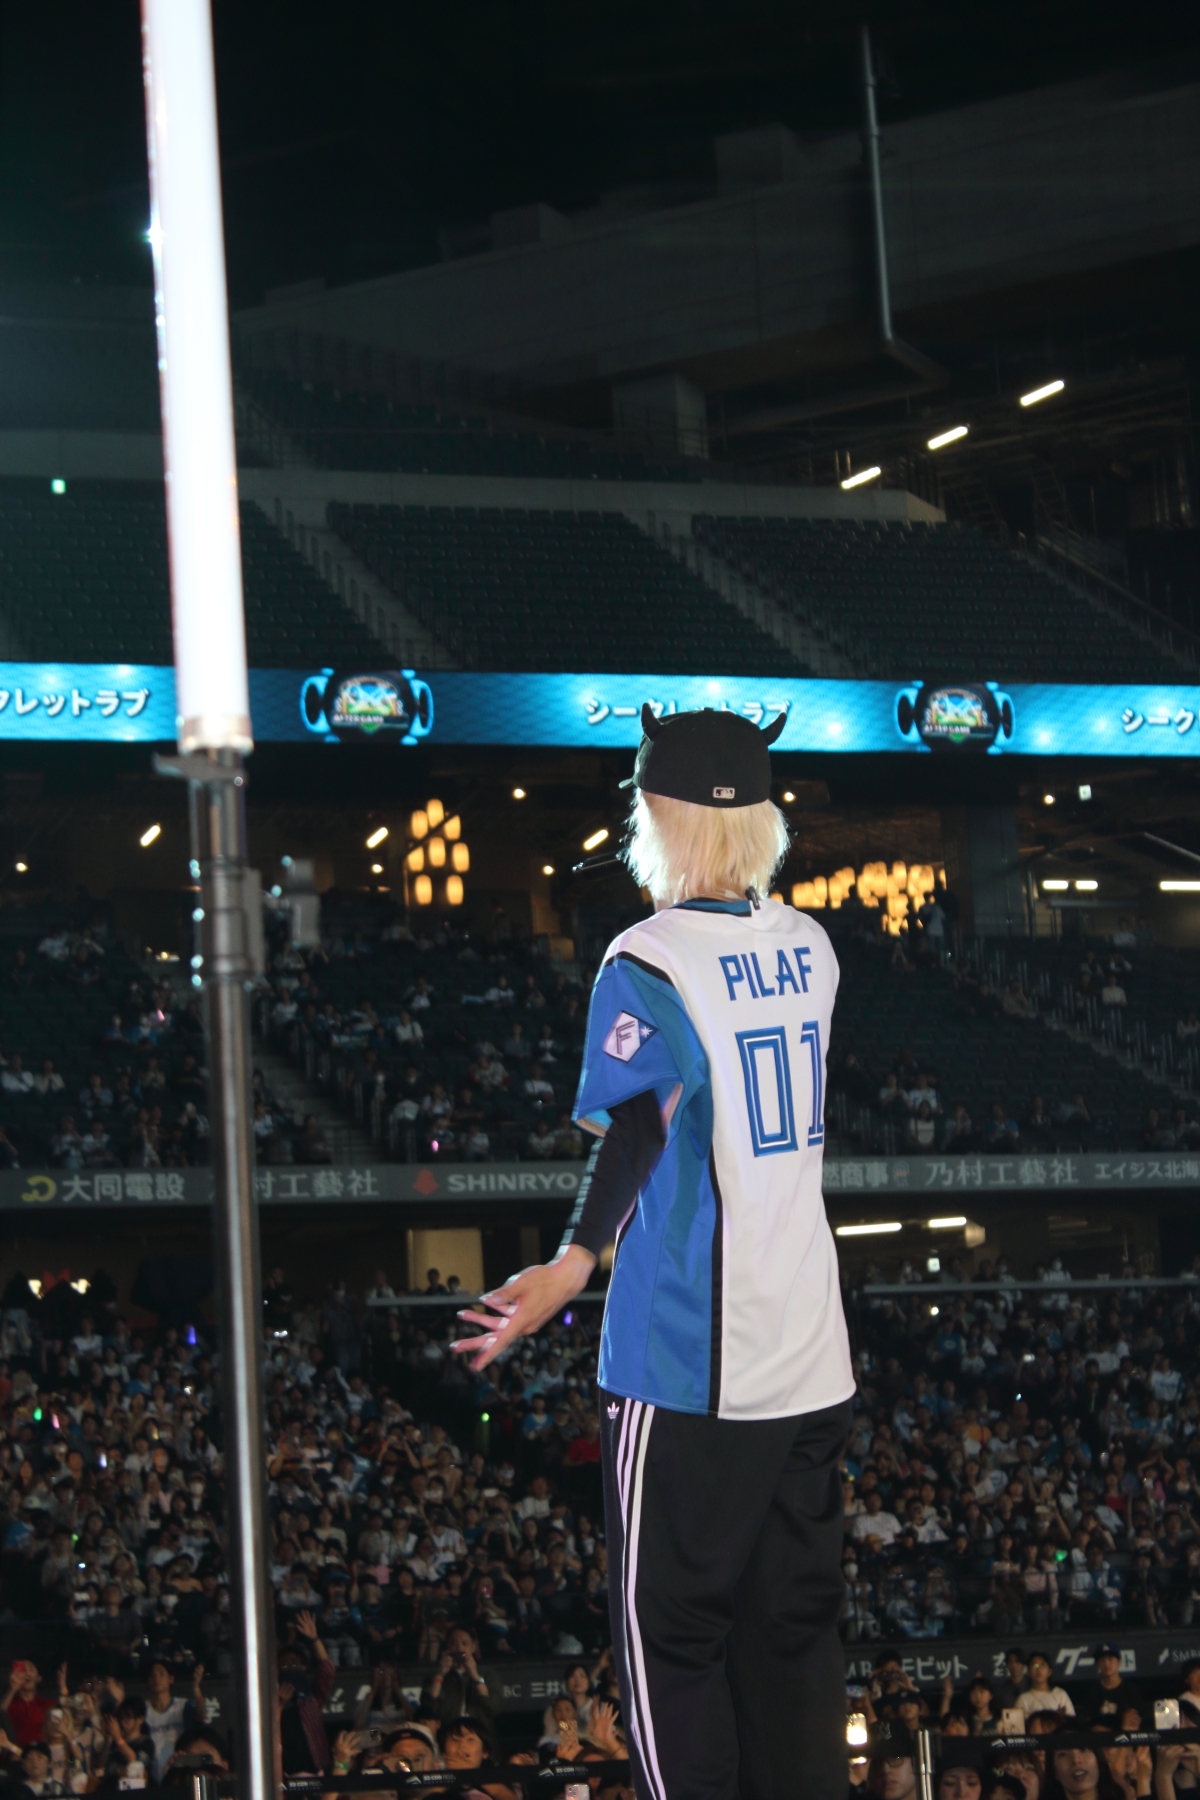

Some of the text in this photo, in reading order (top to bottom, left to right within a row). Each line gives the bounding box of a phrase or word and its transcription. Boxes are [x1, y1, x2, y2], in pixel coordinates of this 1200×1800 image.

[1121, 708, 1200, 735] シーク
[718, 946, 812, 1001] PILAF
[735, 1020, 824, 1158] 01
[62, 1173, 185, 1202] 大同電設
[208, 1169, 380, 1198] 村工藝社
[448, 1172, 579, 1193] SHINRYO
